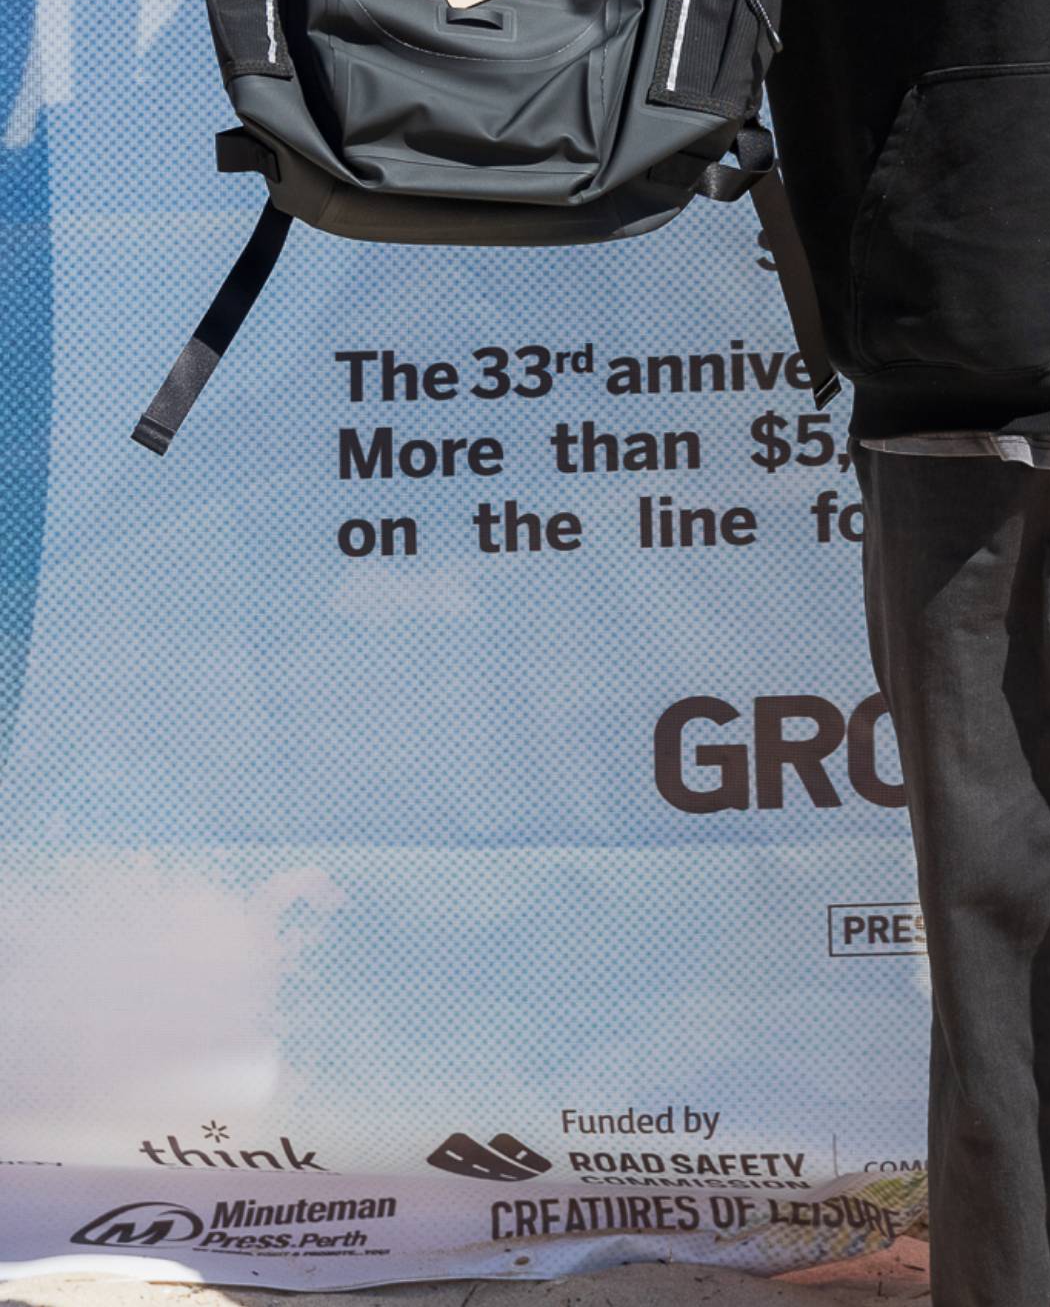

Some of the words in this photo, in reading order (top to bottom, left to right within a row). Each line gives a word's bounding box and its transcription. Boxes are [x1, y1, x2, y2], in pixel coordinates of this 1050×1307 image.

[335, 349, 459, 402] The
[470, 343, 594, 398] 33rd
[339, 427, 503, 479] More
[551, 422, 701, 473] than
[337, 515, 417, 557] on
[472, 500, 583, 553] the
[639, 496, 757, 547] line
[561, 1108, 674, 1134] Funded
[684, 1106, 720, 1140] by
[140, 1122, 330, 1171] think
[569, 1152, 665, 1173] ROAD
[671, 1153, 804, 1177] SAFETY
[581, 1175, 811, 1190] COMMISSION
[210, 1196, 397, 1229] Minuteman
[709, 1196, 755, 1229] OF
